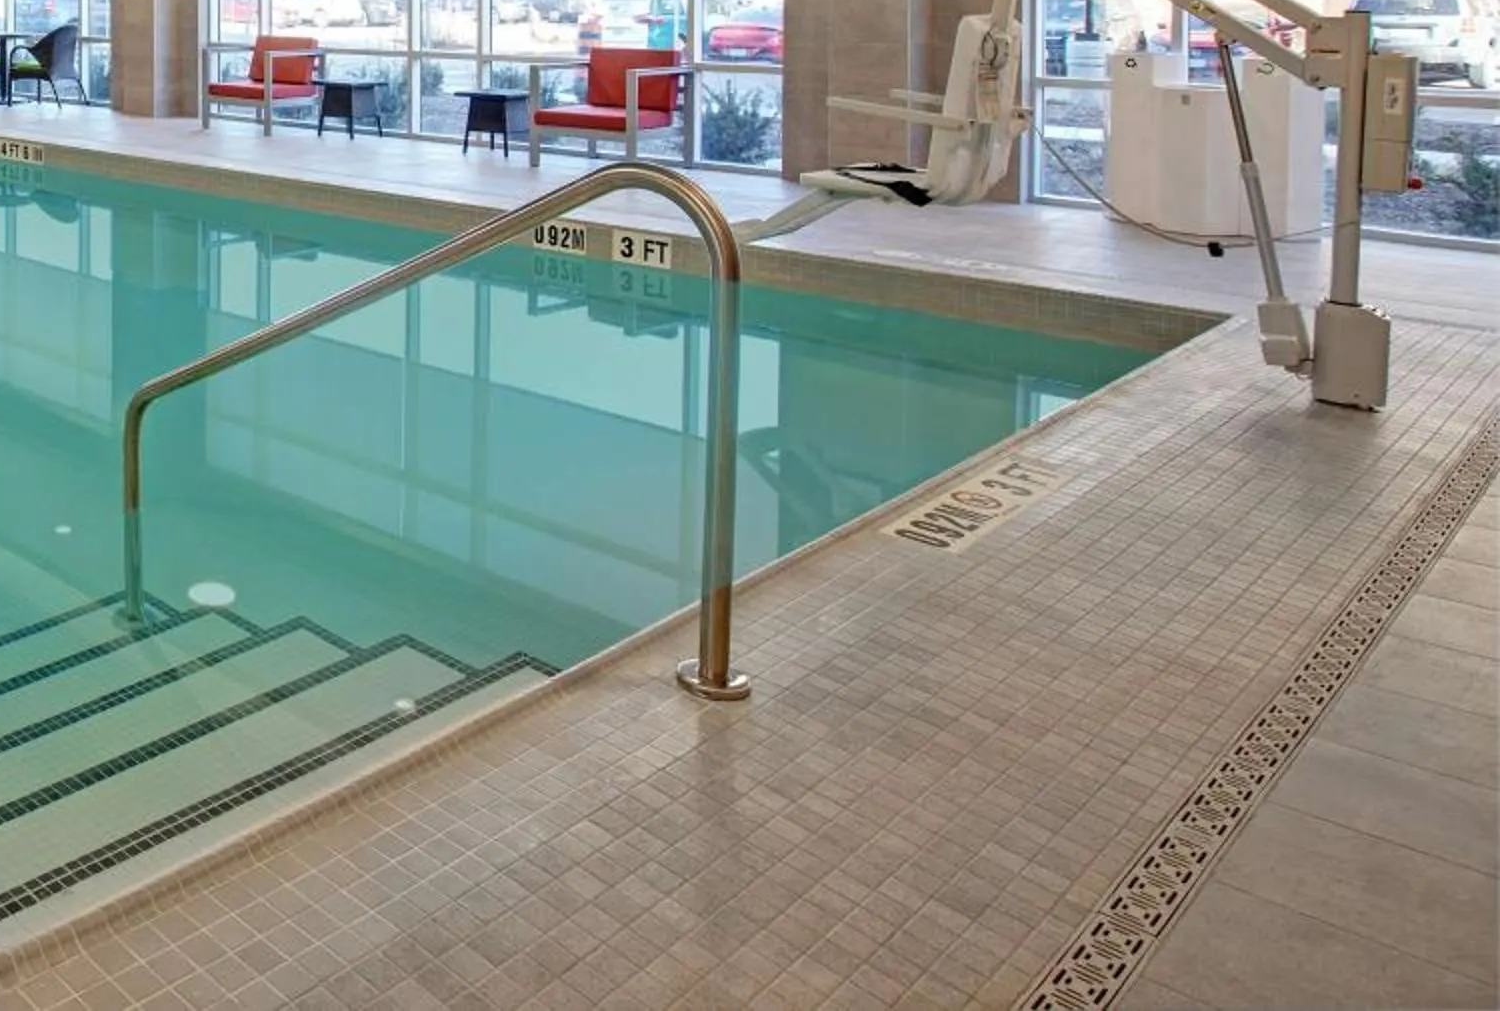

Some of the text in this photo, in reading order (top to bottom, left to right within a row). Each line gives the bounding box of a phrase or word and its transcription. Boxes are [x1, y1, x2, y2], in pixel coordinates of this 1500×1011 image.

[619, 236, 634, 258] 3
[643, 239, 669, 264] FT
[998, 462, 1060, 487] FT
[981, 478, 1033, 497] 3
